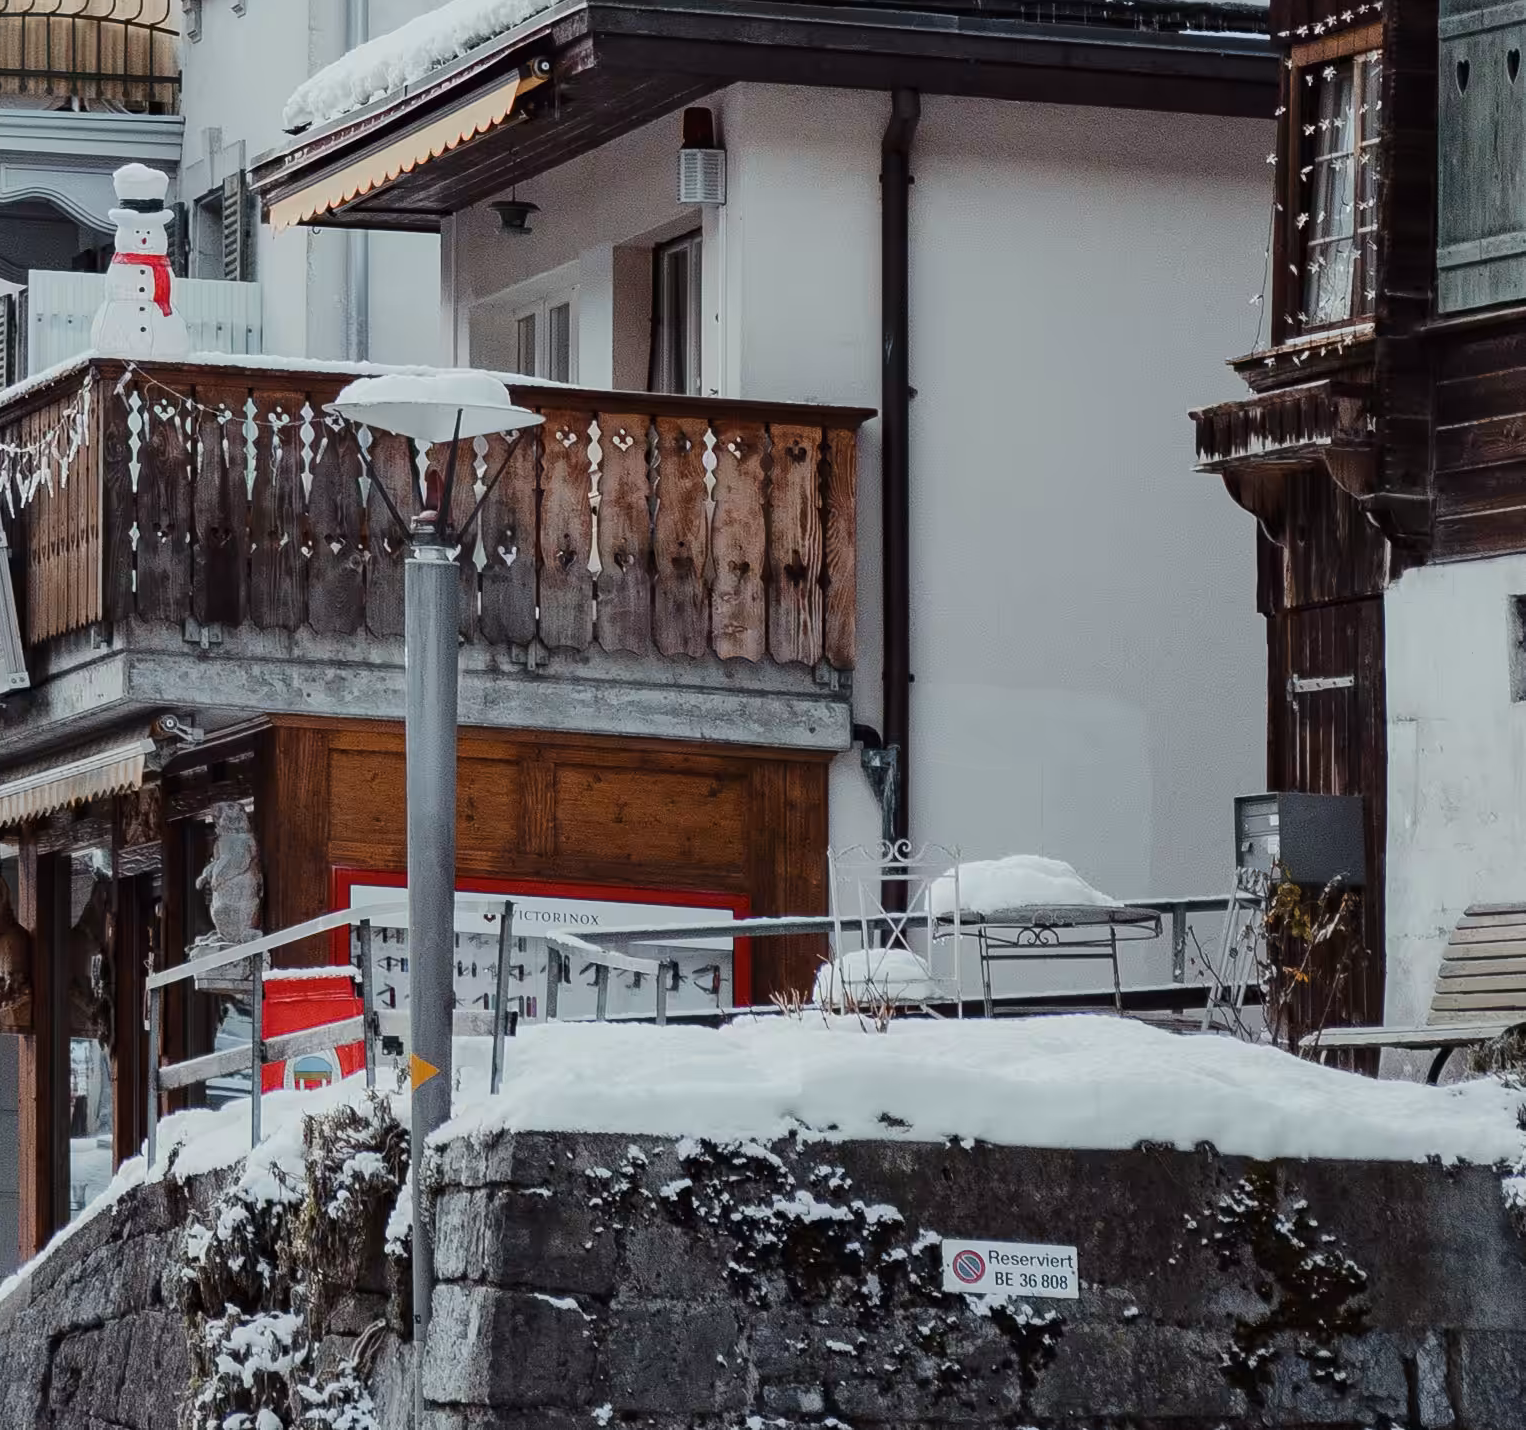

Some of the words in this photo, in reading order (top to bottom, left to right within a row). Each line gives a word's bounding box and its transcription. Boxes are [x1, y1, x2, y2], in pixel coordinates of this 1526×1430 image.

[513, 910, 600, 925] ICTORINOX
[989, 1250, 1073, 1269] Reserviert
[995, 1272, 1014, 1287] BE
[1020, 1273, 1038, 1288] 36
[1041, 1274, 1068, 1289] 808
